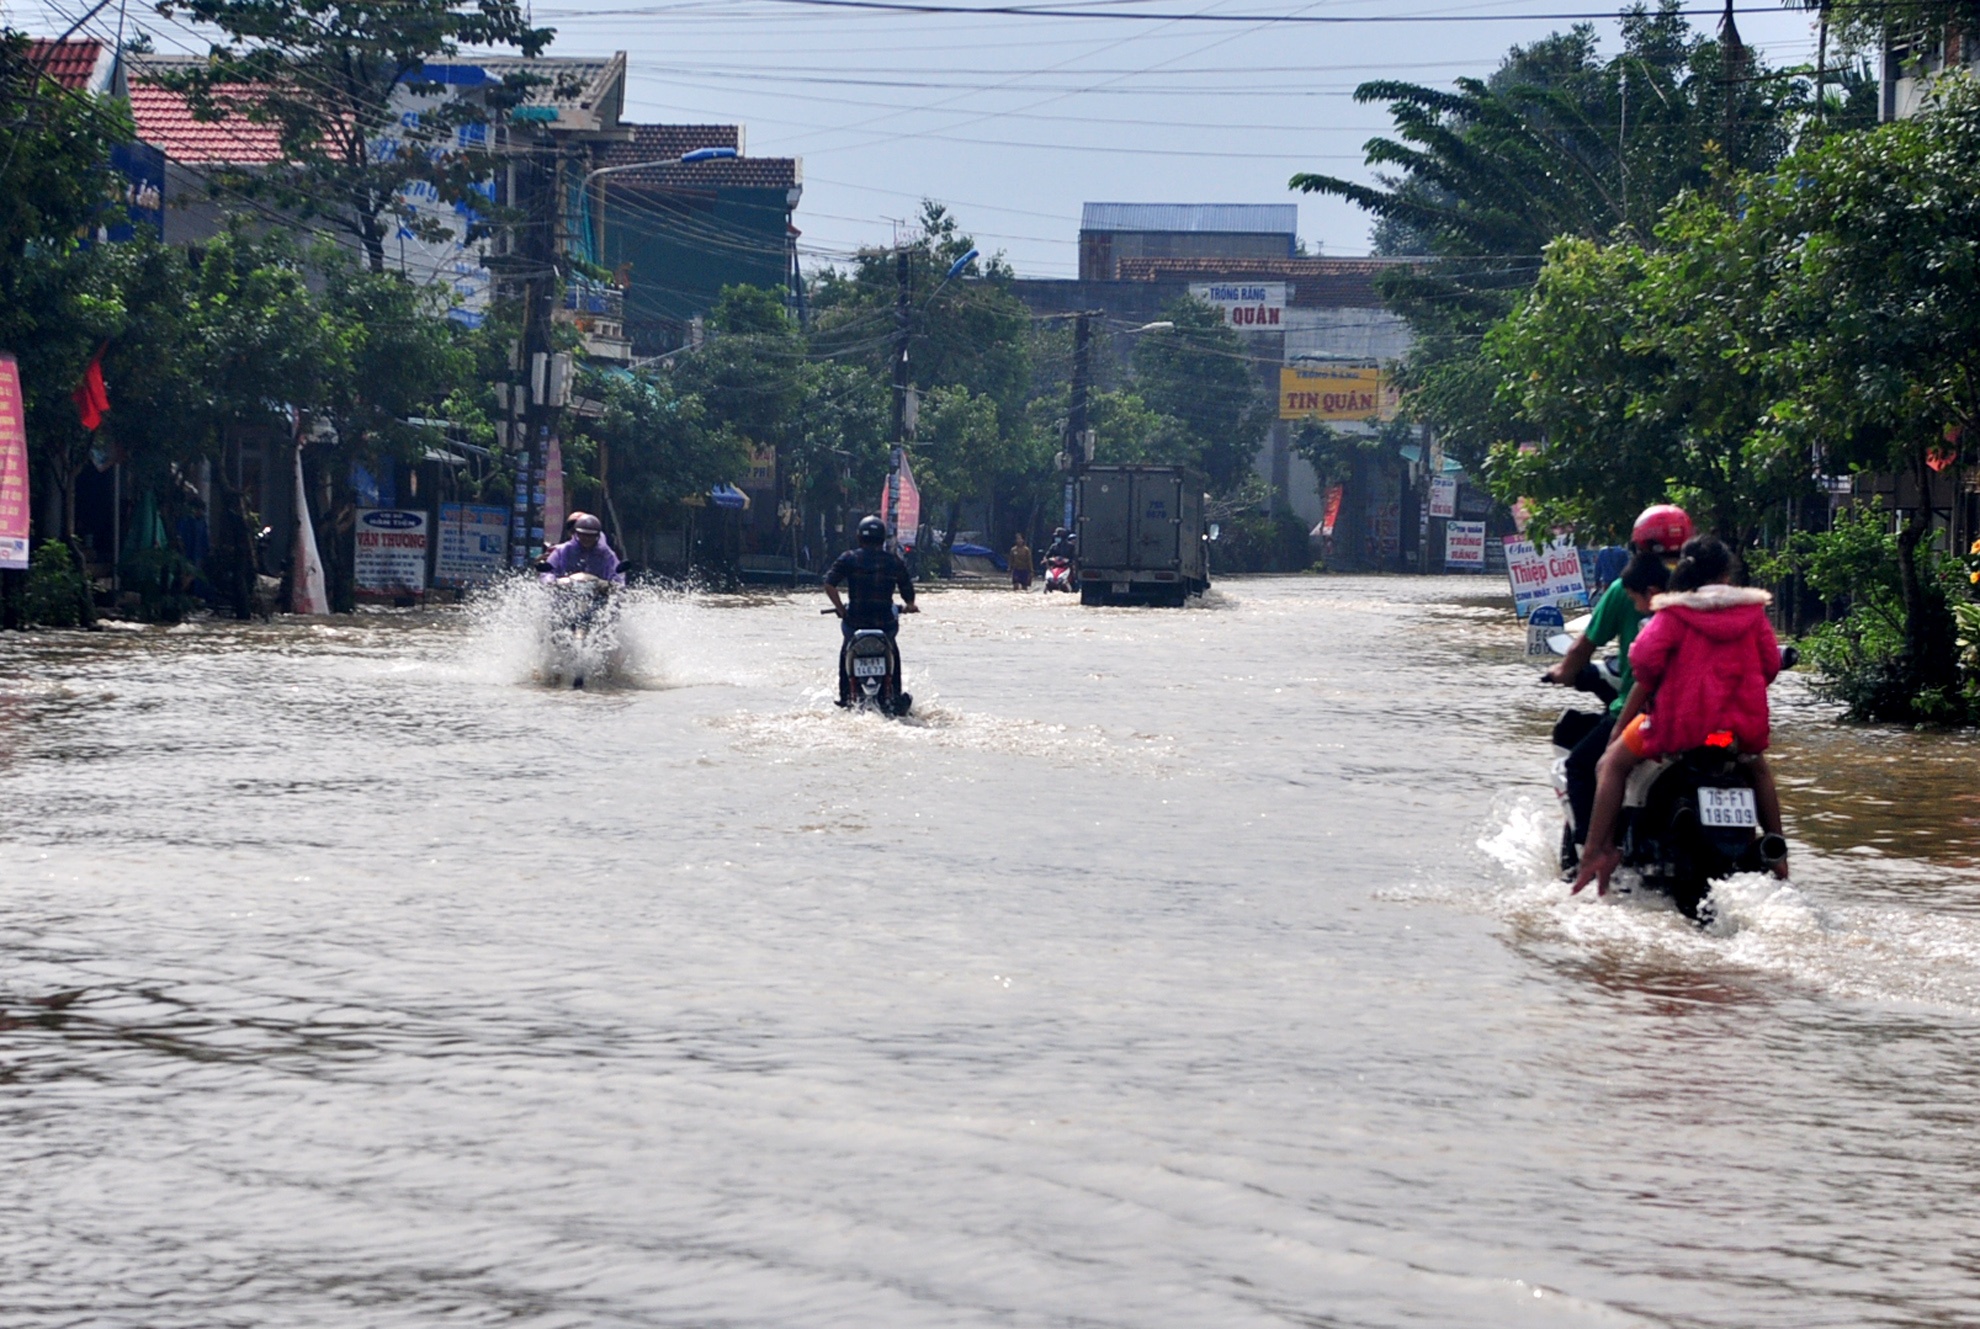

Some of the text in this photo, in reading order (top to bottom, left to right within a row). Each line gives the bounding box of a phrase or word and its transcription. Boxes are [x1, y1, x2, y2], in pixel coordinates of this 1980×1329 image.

[1232, 303, 1280, 326] QUÂN
[1287, 390, 1373, 413] TIN QUÂN
[1511, 558, 1548, 587] Thiệp
[1516, 591, 1532, 602] SINH
[1570, 582, 1583, 592] GIA
[1707, 790, 1746, 807] 76-F1
[1705, 808, 1753, 824] 186.09
